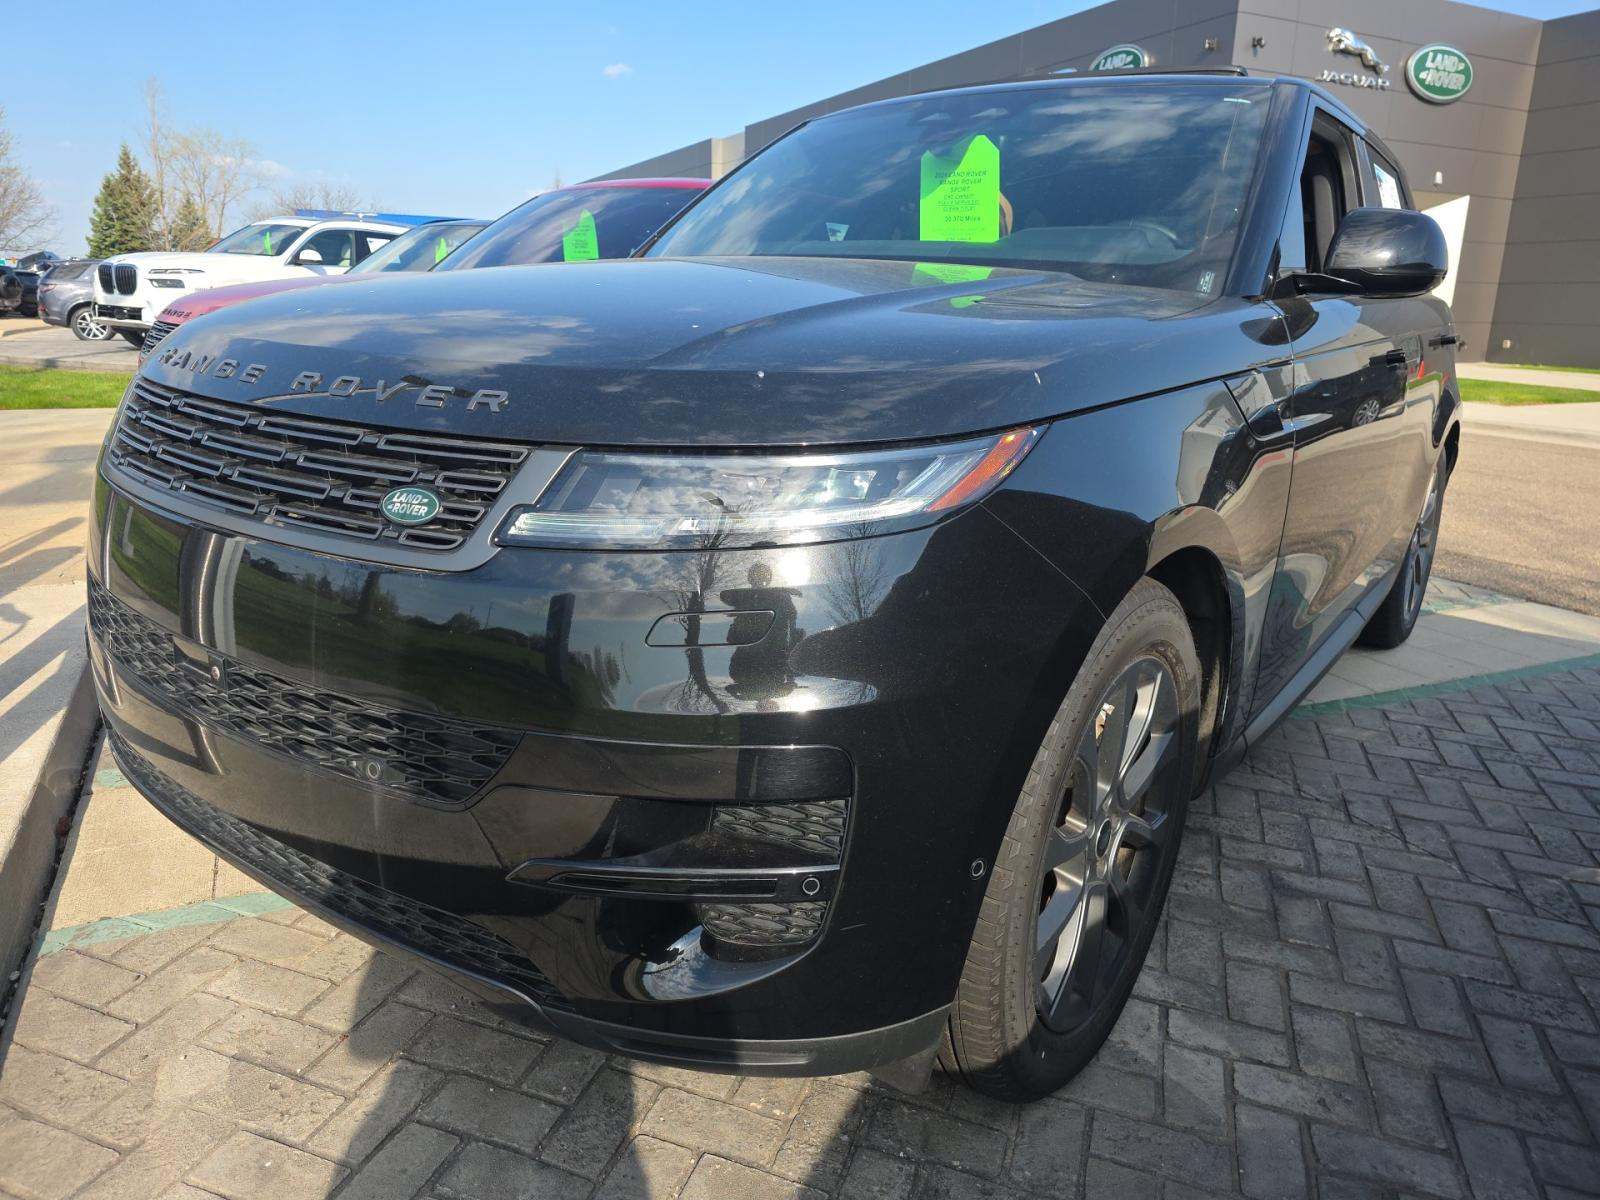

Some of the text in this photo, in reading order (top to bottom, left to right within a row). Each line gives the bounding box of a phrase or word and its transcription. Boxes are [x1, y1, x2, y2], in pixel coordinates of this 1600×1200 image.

[1425, 51, 1464, 72] LAND
[1315, 69, 1391, 90] JAGUAR
[1420, 69, 1466, 91] ROVER
[965, 169, 987, 177] ROVER
[938, 178, 958, 186] RANGE
[950, 185, 970, 193] SPORT
[159, 348, 509, 413] RANGE ROVER
[392, 491, 422, 504] LAND
[392, 502, 428, 516] ROVER
